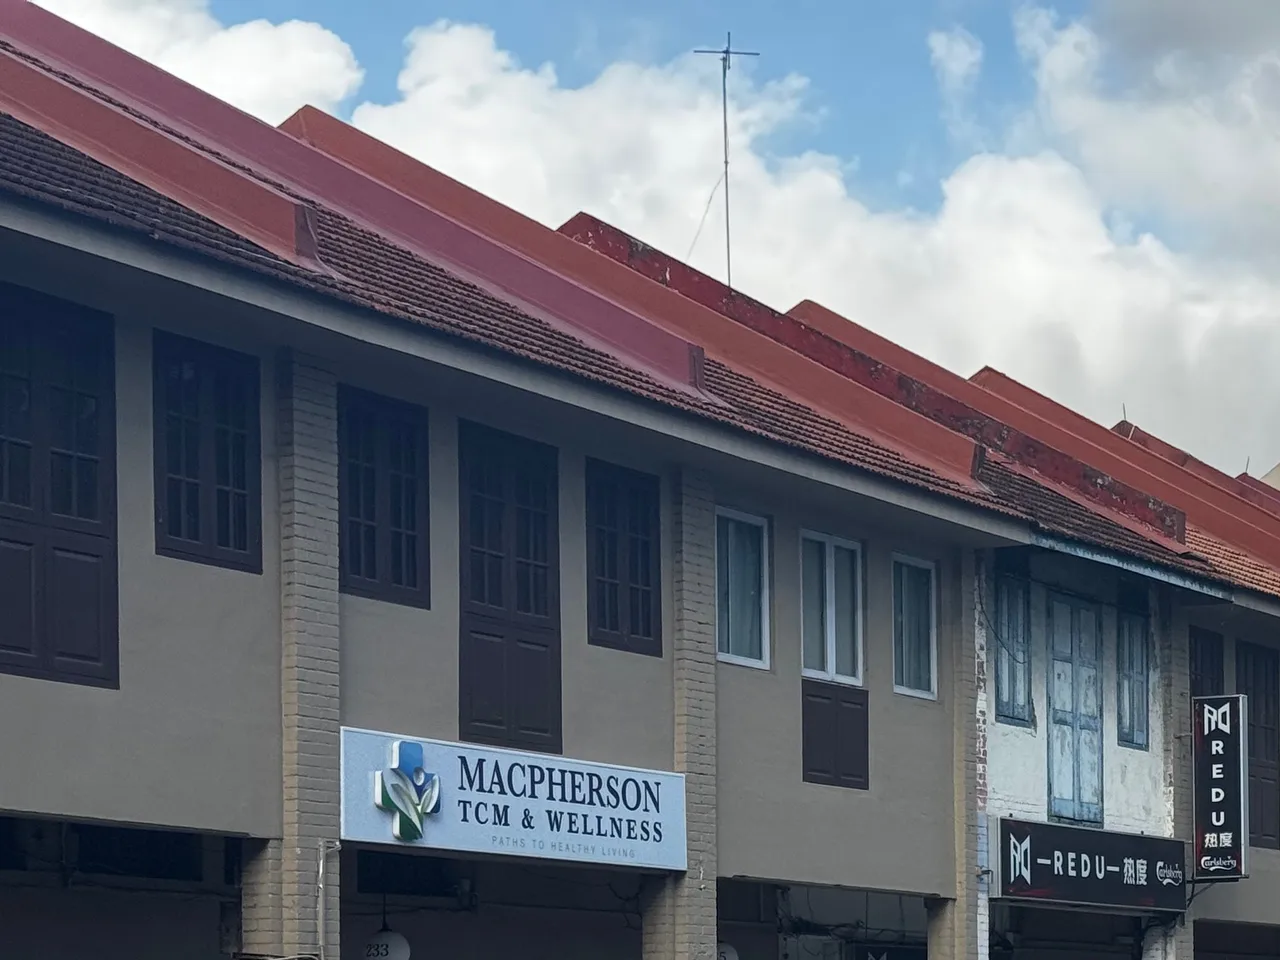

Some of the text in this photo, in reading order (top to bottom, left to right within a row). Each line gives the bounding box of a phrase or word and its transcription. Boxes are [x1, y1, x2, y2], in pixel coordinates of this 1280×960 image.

[457, 755, 661, 813] MACPHERSON
[457, 800, 663, 843] TCM & WELLNESS
[492, 836, 636, 859] PATHS TO HEALTHY LIVING
[1123, 857, 1148, 885] 热度
[1156, 861, 1183, 886] Carlsberg
[1201, 856, 1237, 872] Carlsberg
[366, 943, 389, 957] 233
